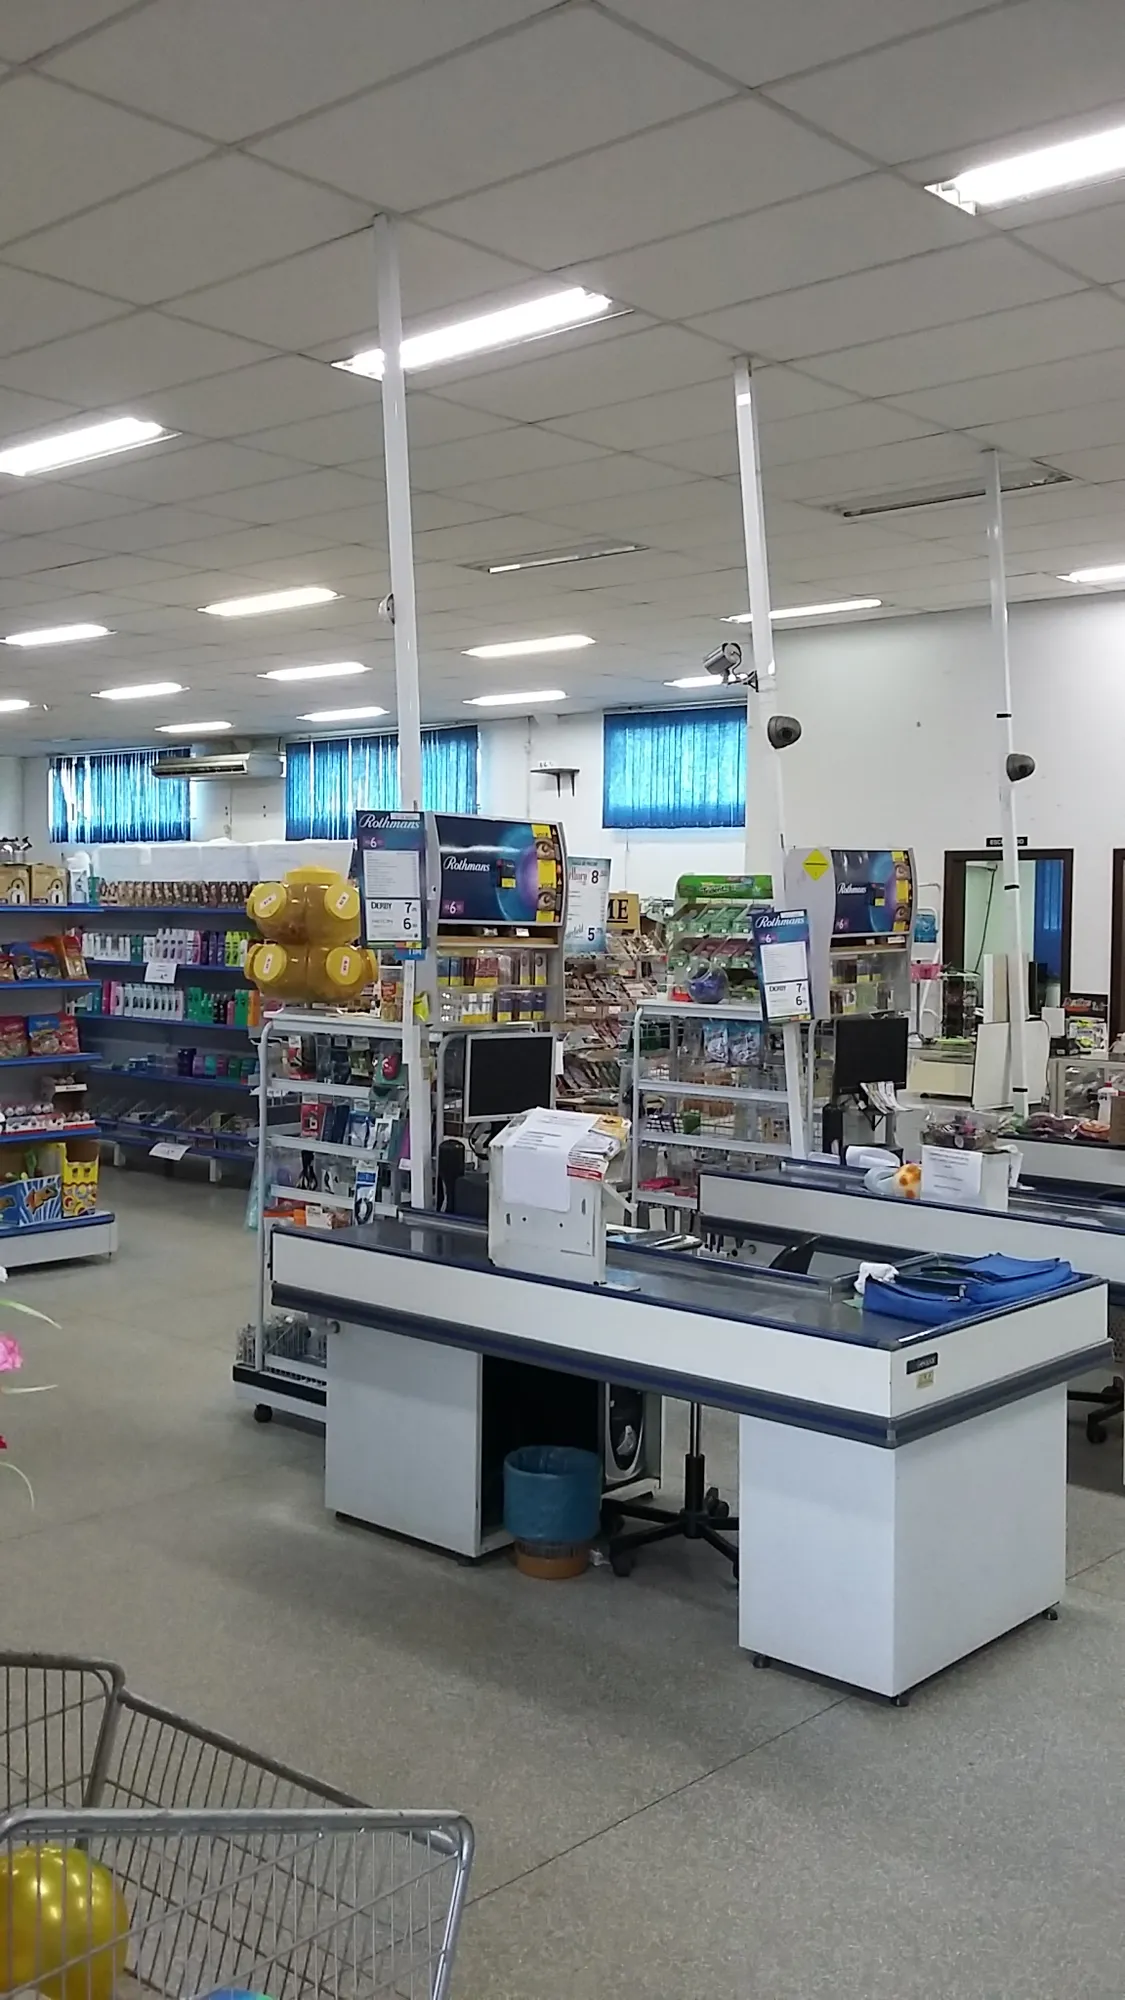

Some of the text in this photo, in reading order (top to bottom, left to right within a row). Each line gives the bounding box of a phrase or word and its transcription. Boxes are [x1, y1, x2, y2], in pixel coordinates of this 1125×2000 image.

[359, 813, 420, 829] Rothmans
[443, 855, 490, 872] Rothmans
[755, 915, 805, 928] Rothmans
